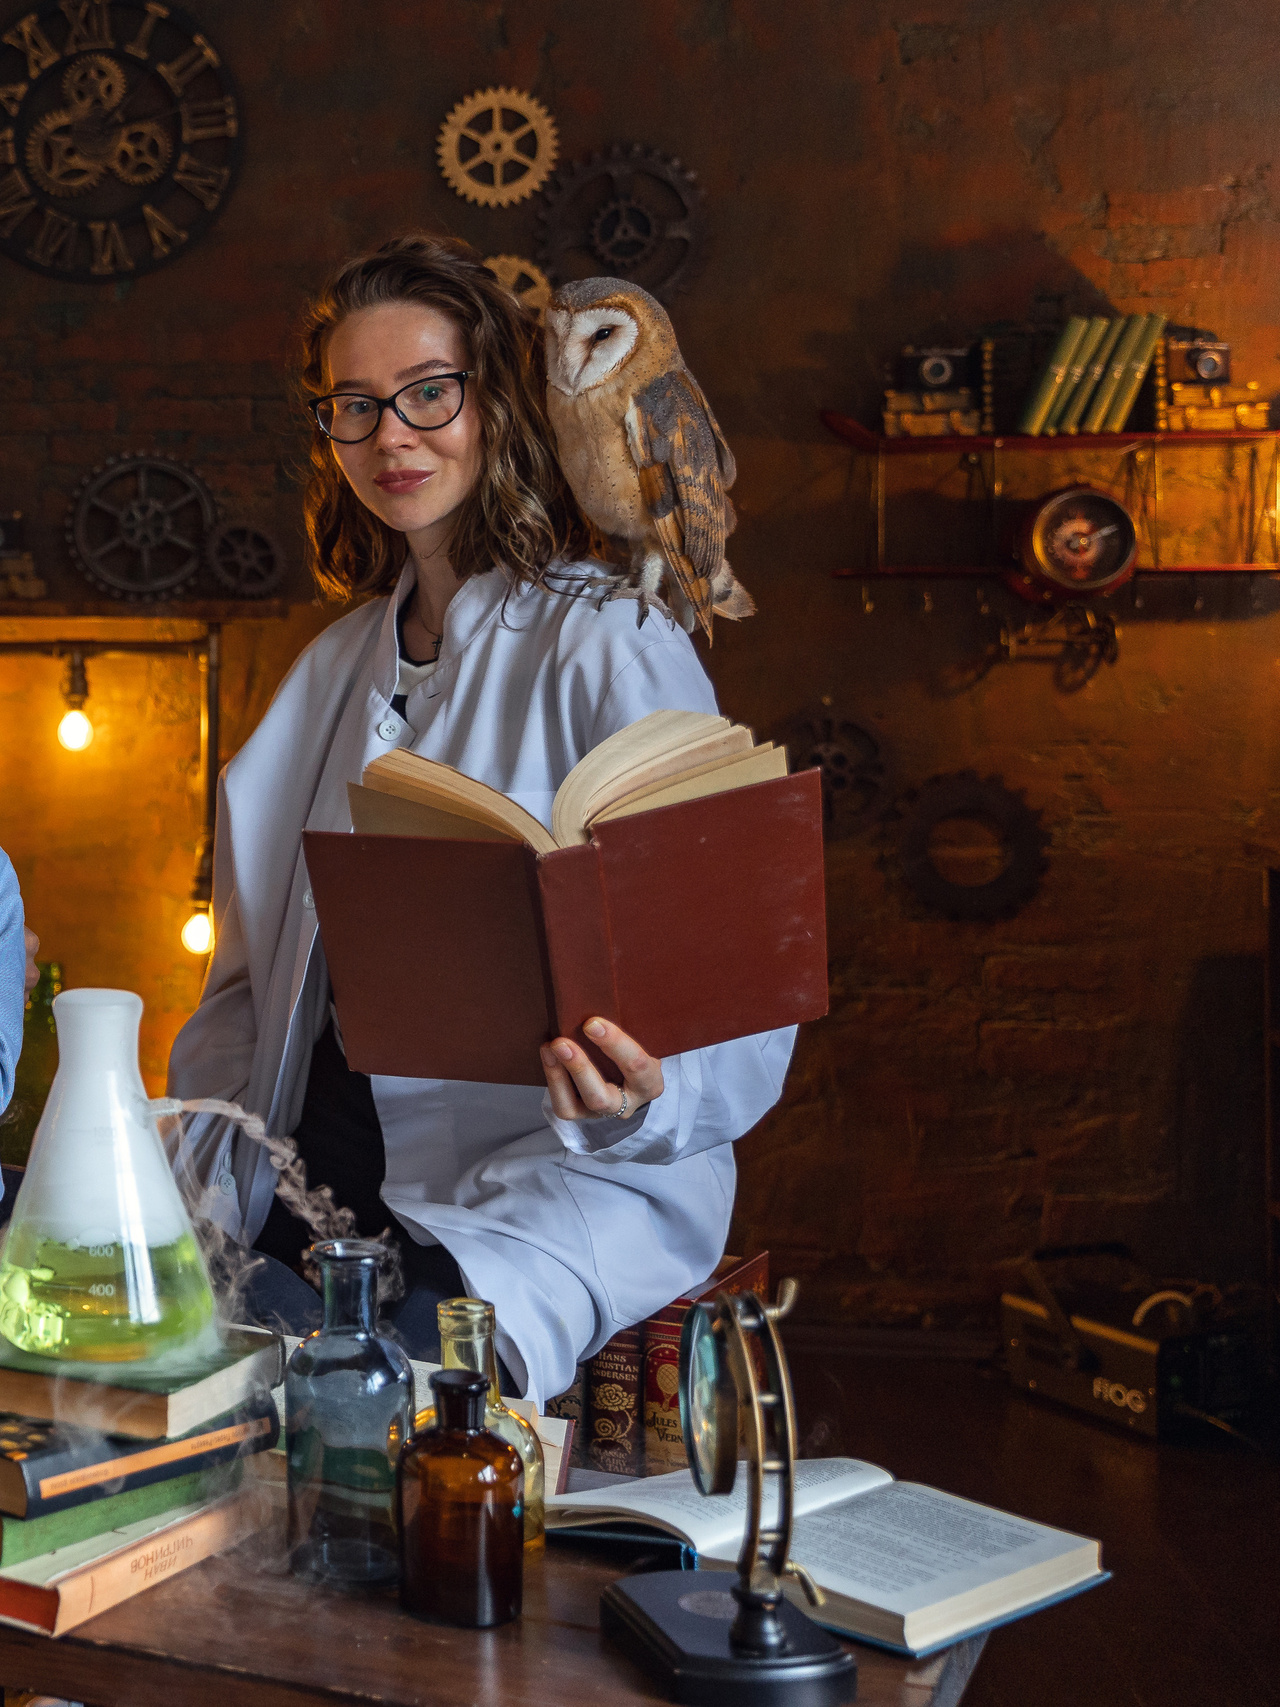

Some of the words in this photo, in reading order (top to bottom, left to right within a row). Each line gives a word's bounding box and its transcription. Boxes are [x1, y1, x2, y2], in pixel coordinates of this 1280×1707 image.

[88, 1284, 115, 1296] 400
[599, 1351, 627, 1363] HANS
[130, 1535, 194, 1574] ЧИГРИНОВ
[144, 1555, 177, 1581] ИВАН
